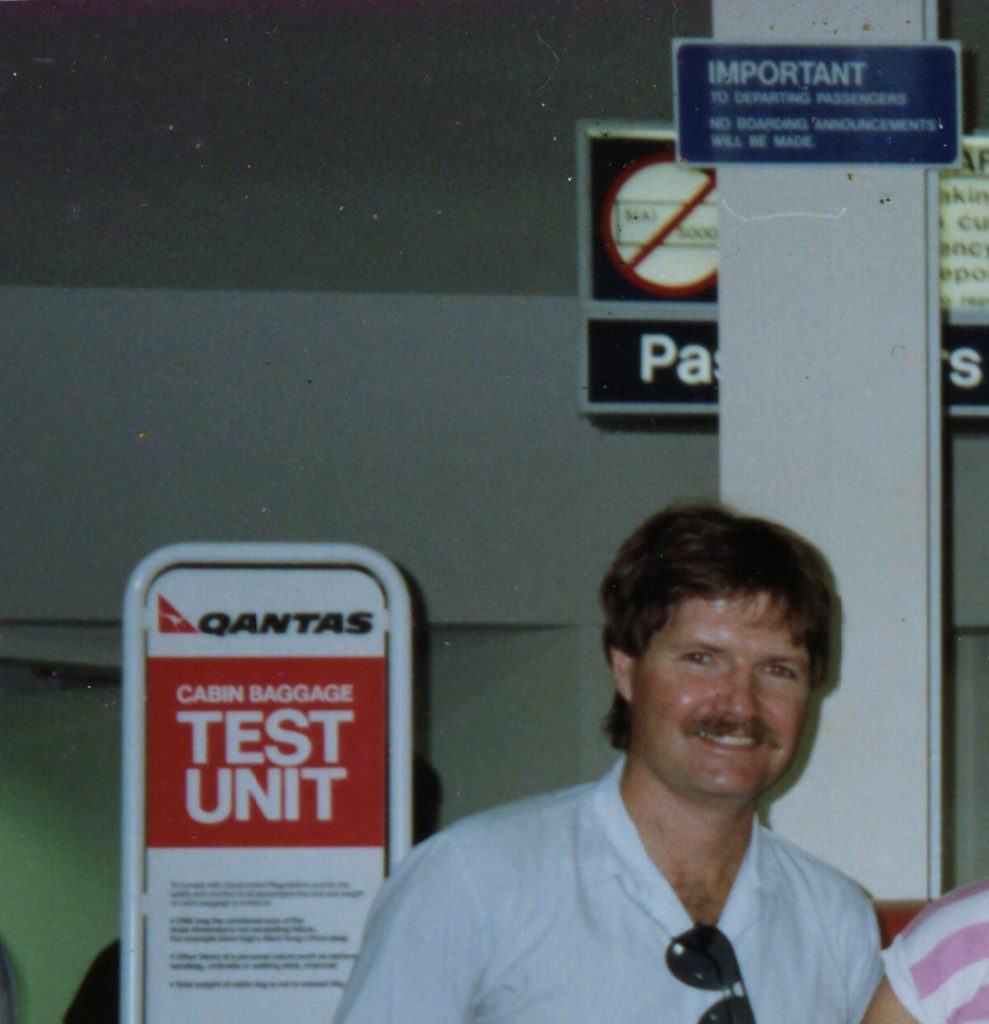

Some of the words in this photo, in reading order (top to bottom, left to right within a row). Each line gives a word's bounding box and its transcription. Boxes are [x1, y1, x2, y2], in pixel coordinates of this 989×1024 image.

[708, 60, 866, 86] IMPORTANT
[711, 91, 728, 104] TO
[735, 91, 811, 105] DEPARTING
[816, 91, 907, 106] PASSENGERS
[710, 117, 730, 131] NO
[737, 117, 808, 131] BOARDING
[814, 118, 936, 132] ANNOUNCEMENTS
[711, 134, 742, 148] WILL
[749, 134, 767, 148] BE
[198, 612, 374, 636] QANTAS
[176, 684, 244, 704] CABIN
[249, 684, 354, 704] BAGGAGE
[176, 708, 355, 766] TEST
[186, 767, 348, 824] UNIT
